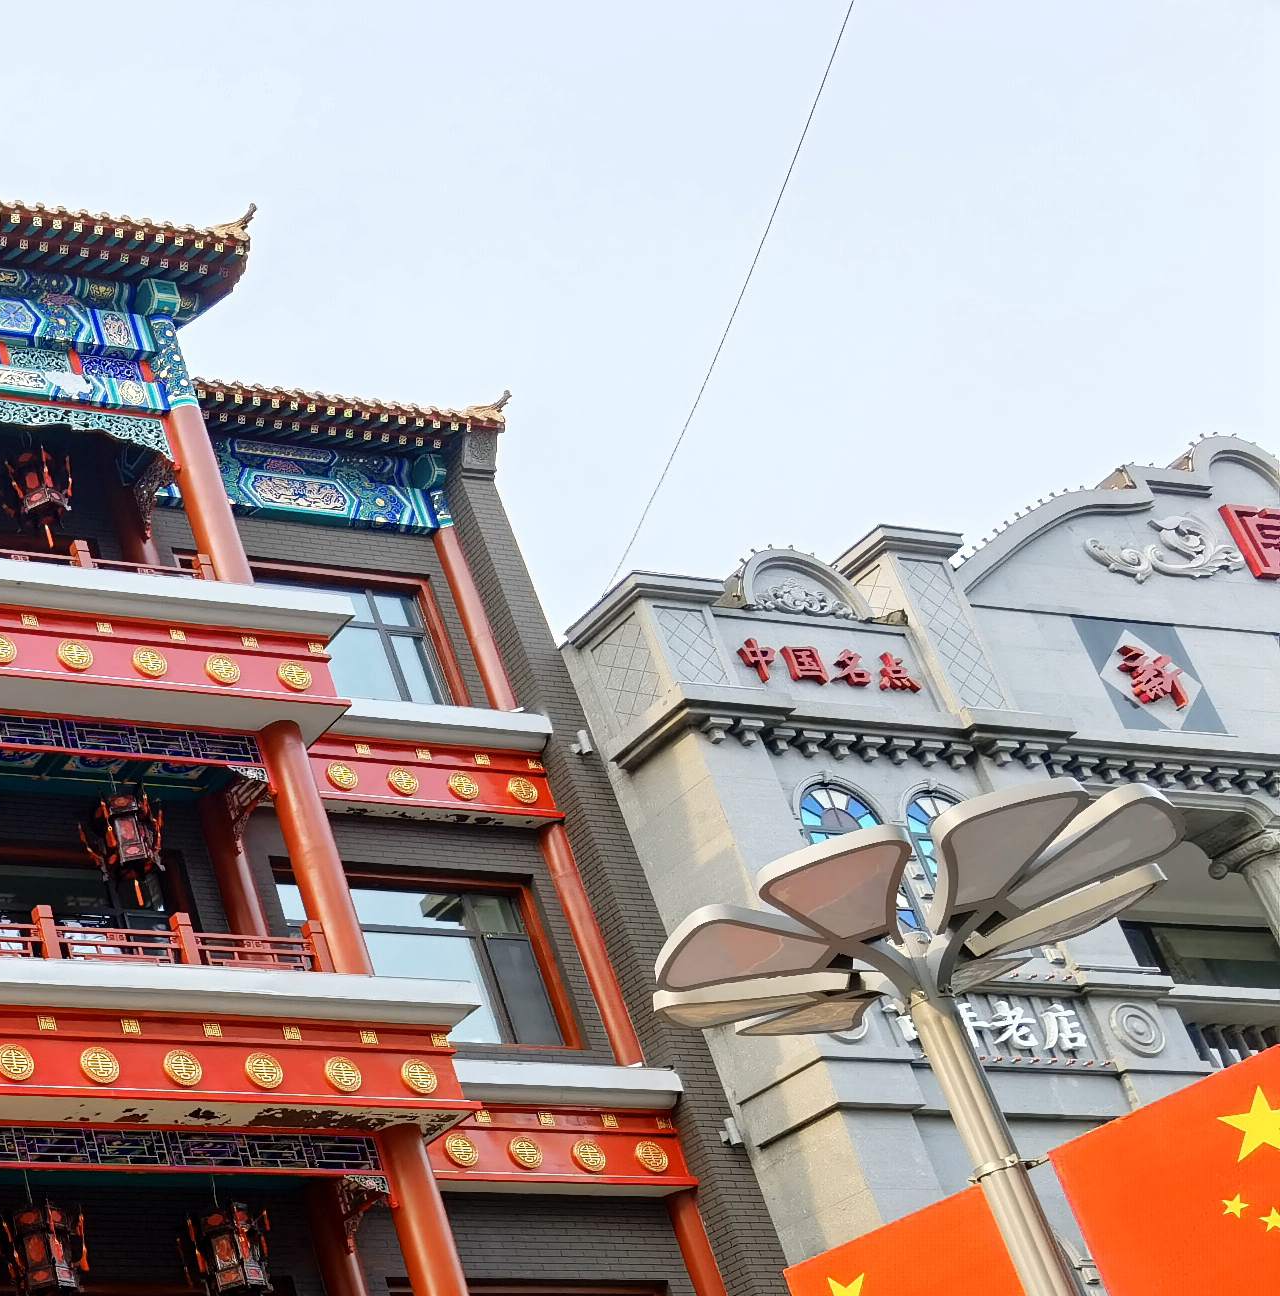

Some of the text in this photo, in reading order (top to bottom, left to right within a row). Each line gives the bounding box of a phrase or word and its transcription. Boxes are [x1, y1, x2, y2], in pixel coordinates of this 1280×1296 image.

[736, 636, 923, 695] 中国名点
[1116, 643, 1192, 712] 新
